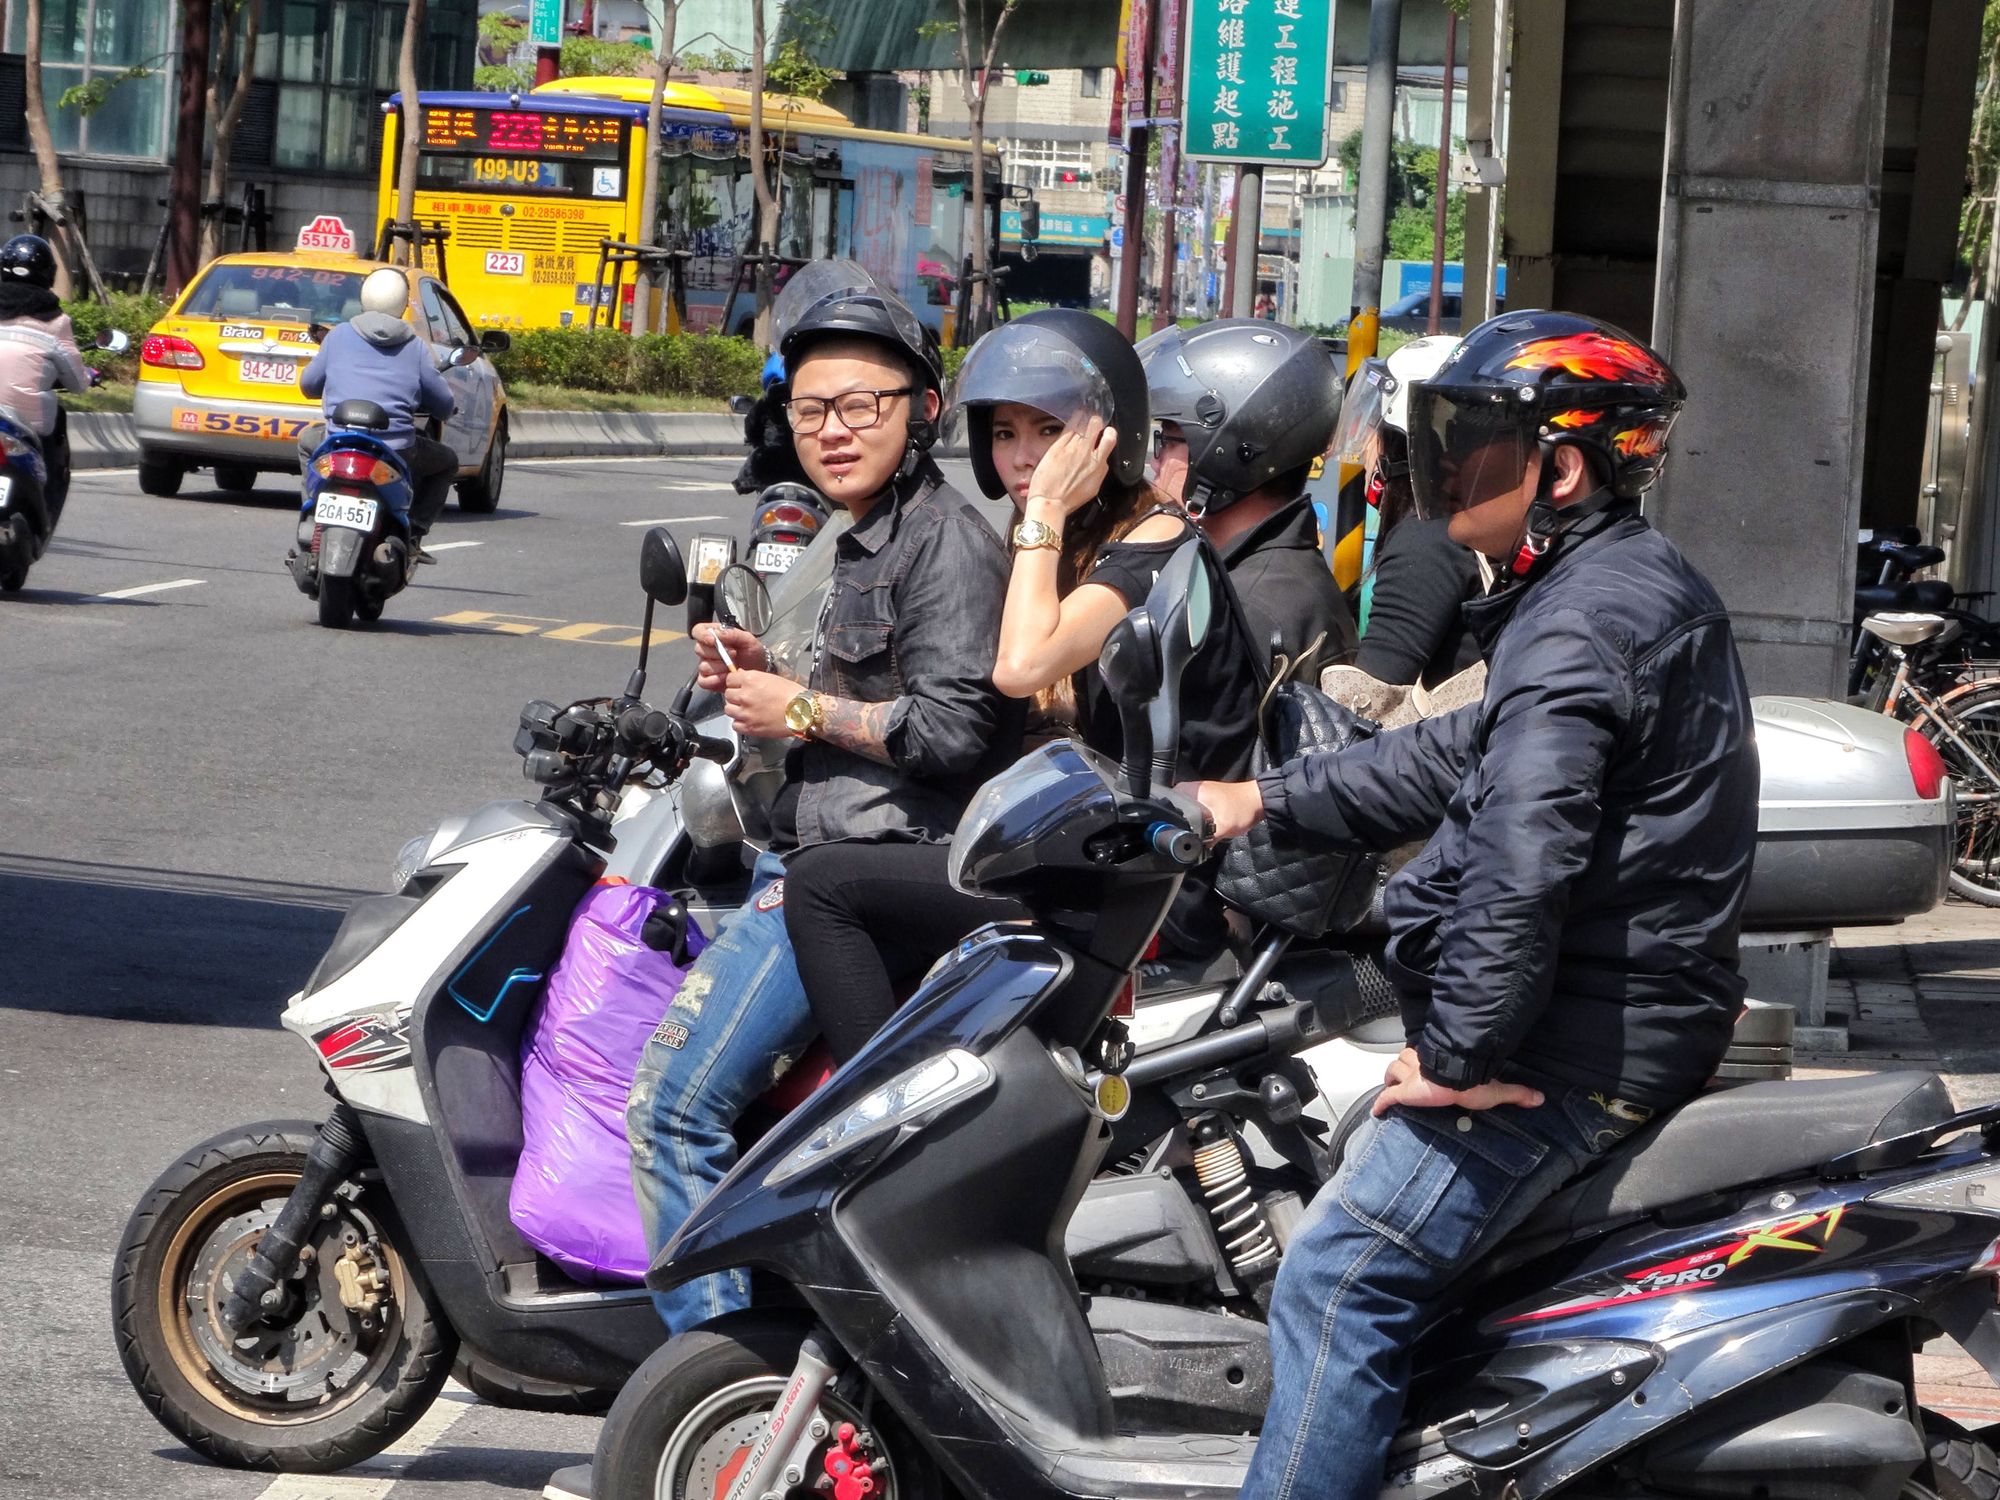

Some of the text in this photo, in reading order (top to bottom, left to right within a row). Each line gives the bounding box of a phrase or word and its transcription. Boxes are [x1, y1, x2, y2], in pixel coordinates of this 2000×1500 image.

[473, 157, 540, 183] 199-U3
[522, 205, 585, 220] 02-28586398
[319, 220, 337, 234] M
[302, 233, 351, 249] 55178
[488, 253, 520, 272] 223
[251, 267, 346, 286] 942-D2
[221, 326, 262, 339] Bravo
[242, 360, 295, 381] 942-D2
[204, 412, 315, 438] 5517
[317, 503, 372, 526] 2GA-551
[771, 1376, 805, 1434] System
